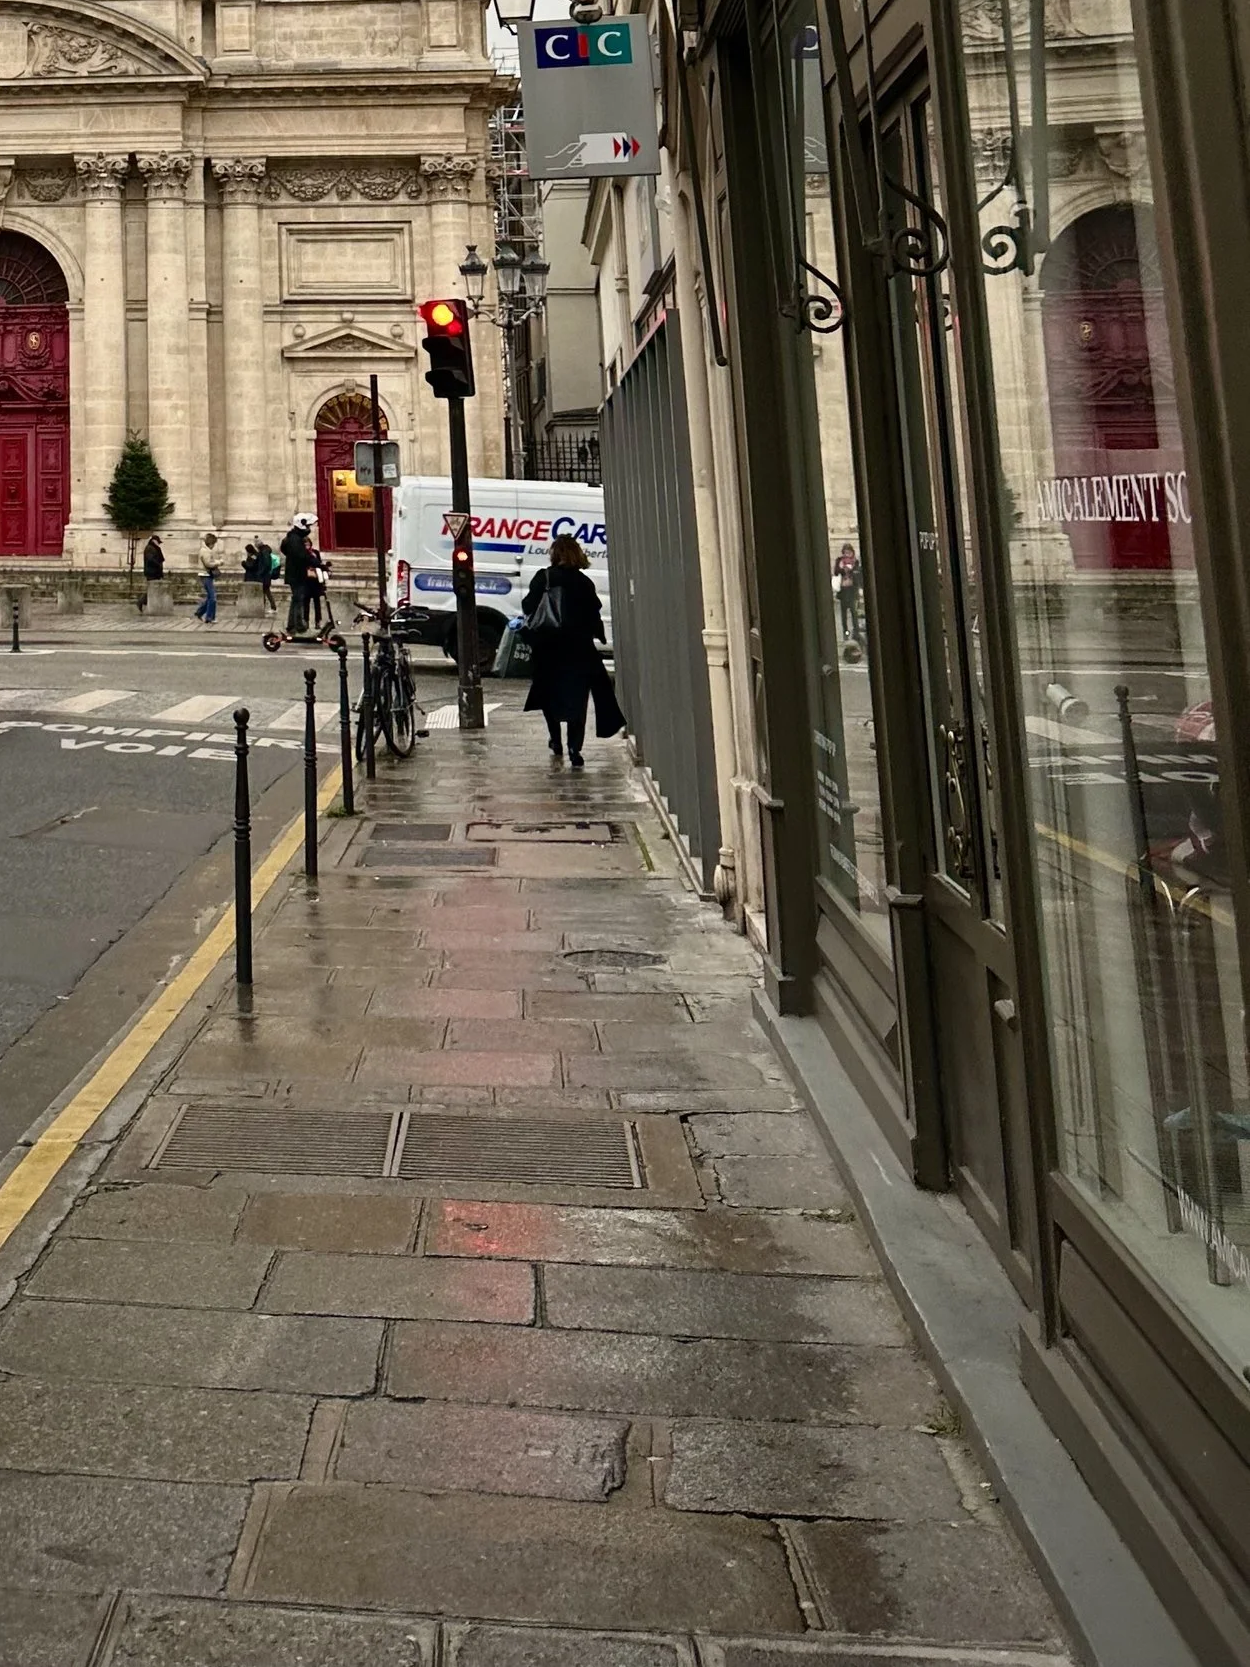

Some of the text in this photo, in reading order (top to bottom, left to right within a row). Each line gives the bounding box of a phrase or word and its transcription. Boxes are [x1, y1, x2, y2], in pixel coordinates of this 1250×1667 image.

[545, 31, 623, 60] CIC
[1036, 472, 1159, 522] AMICALEMENT
[441, 516, 609, 545] RANCECAR
[60, 738, 239, 762] VOIE
